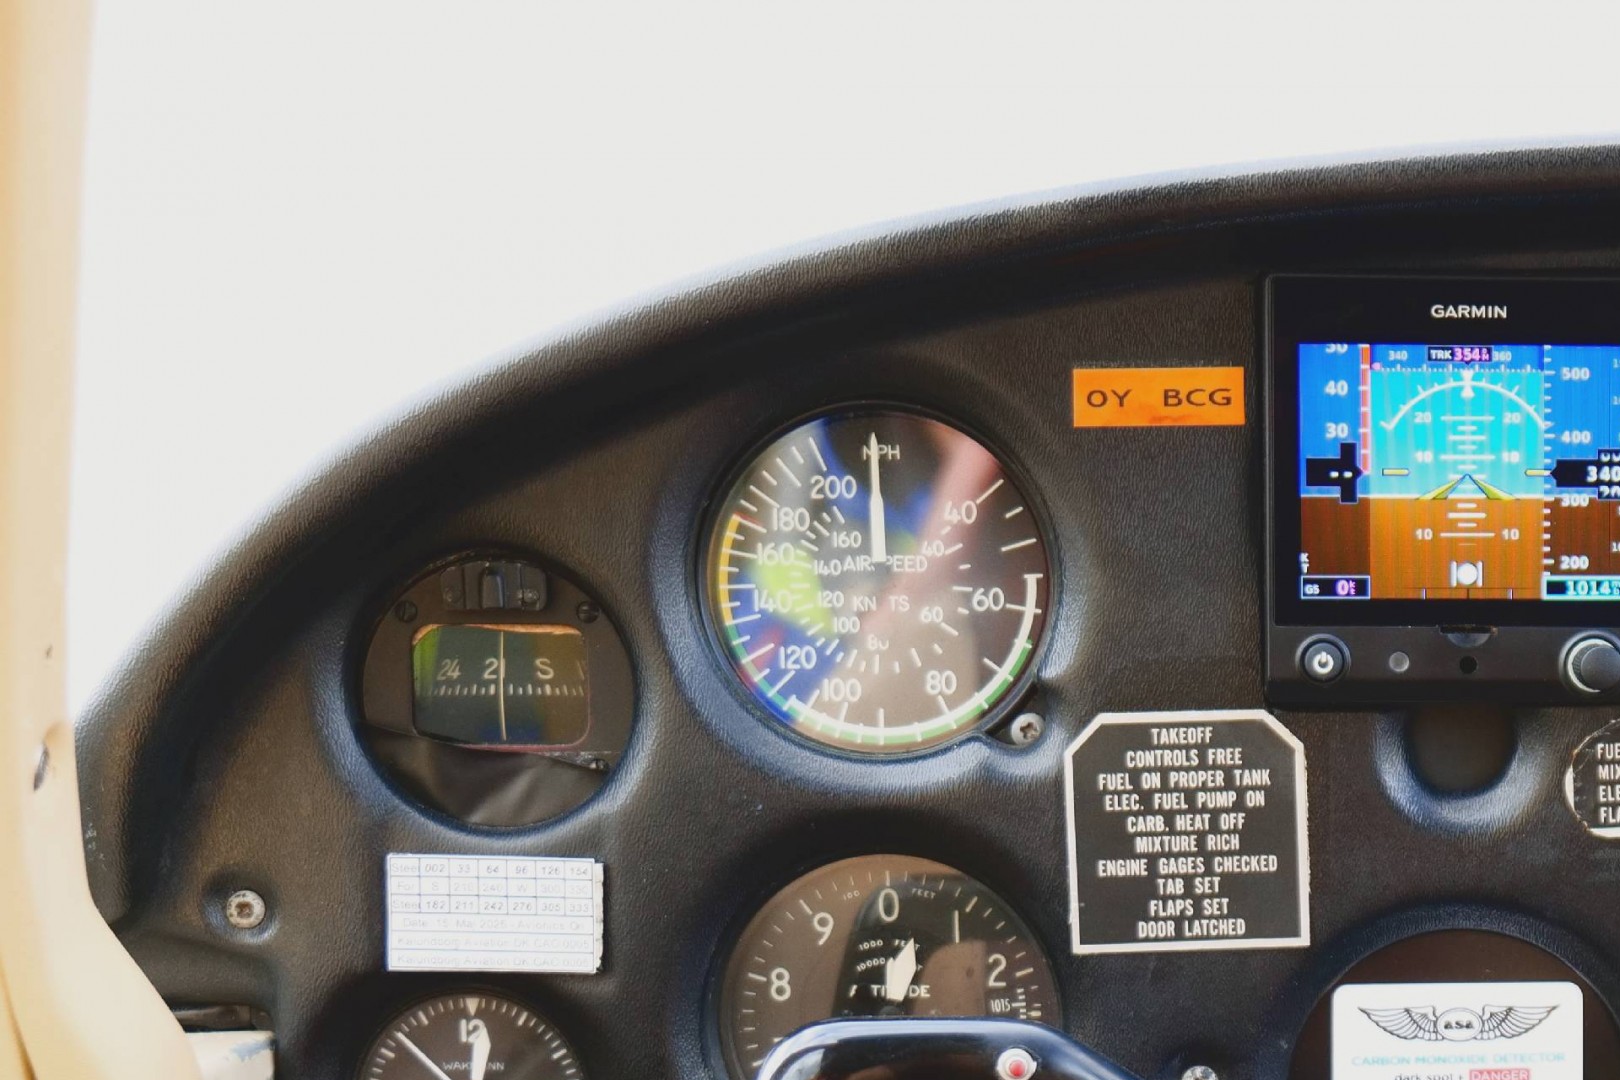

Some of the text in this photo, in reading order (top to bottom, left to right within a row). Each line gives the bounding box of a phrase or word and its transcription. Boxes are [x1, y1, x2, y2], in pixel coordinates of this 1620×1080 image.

[1431, 304, 1507, 319] GARMIN
[1561, 368, 1590, 380] 500
[1087, 389, 1232, 408] OY BCG
[1561, 431, 1591, 443] 400
[811, 476, 857, 499] 200
[1566, 581, 1610, 595] 1014
[972, 588, 1004, 611] 60
[821, 679, 862, 701] 100
[1151, 727, 1213, 745] TAKEOFF
[1126, 748, 1242, 767] CONTROLS FREE
[1099, 769, 1271, 790] FUEL ON PROPER TANK
[1105, 790, 1265, 811] ELEC. FUEL PUMP ON
[1127, 812, 1245, 833] CARB. HEAT OFF
[1136, 833, 1240, 853] MIXTURE RICH
[1099, 855, 1277, 876] ENGINE GAGES CHECKED
[1157, 877, 1220, 896] TAB SET
[879, 888, 900, 921] 0
[1149, 898, 1229, 917] FLAPS SET
[1138, 918, 1246, 939] DOOR LATCHED
[989, 954, 1006, 987] 2
[1352, 1053, 1565, 1066] CARBON MONOXIDE DETECTOR
[1471, 1070, 1528, 1080] DANGER
